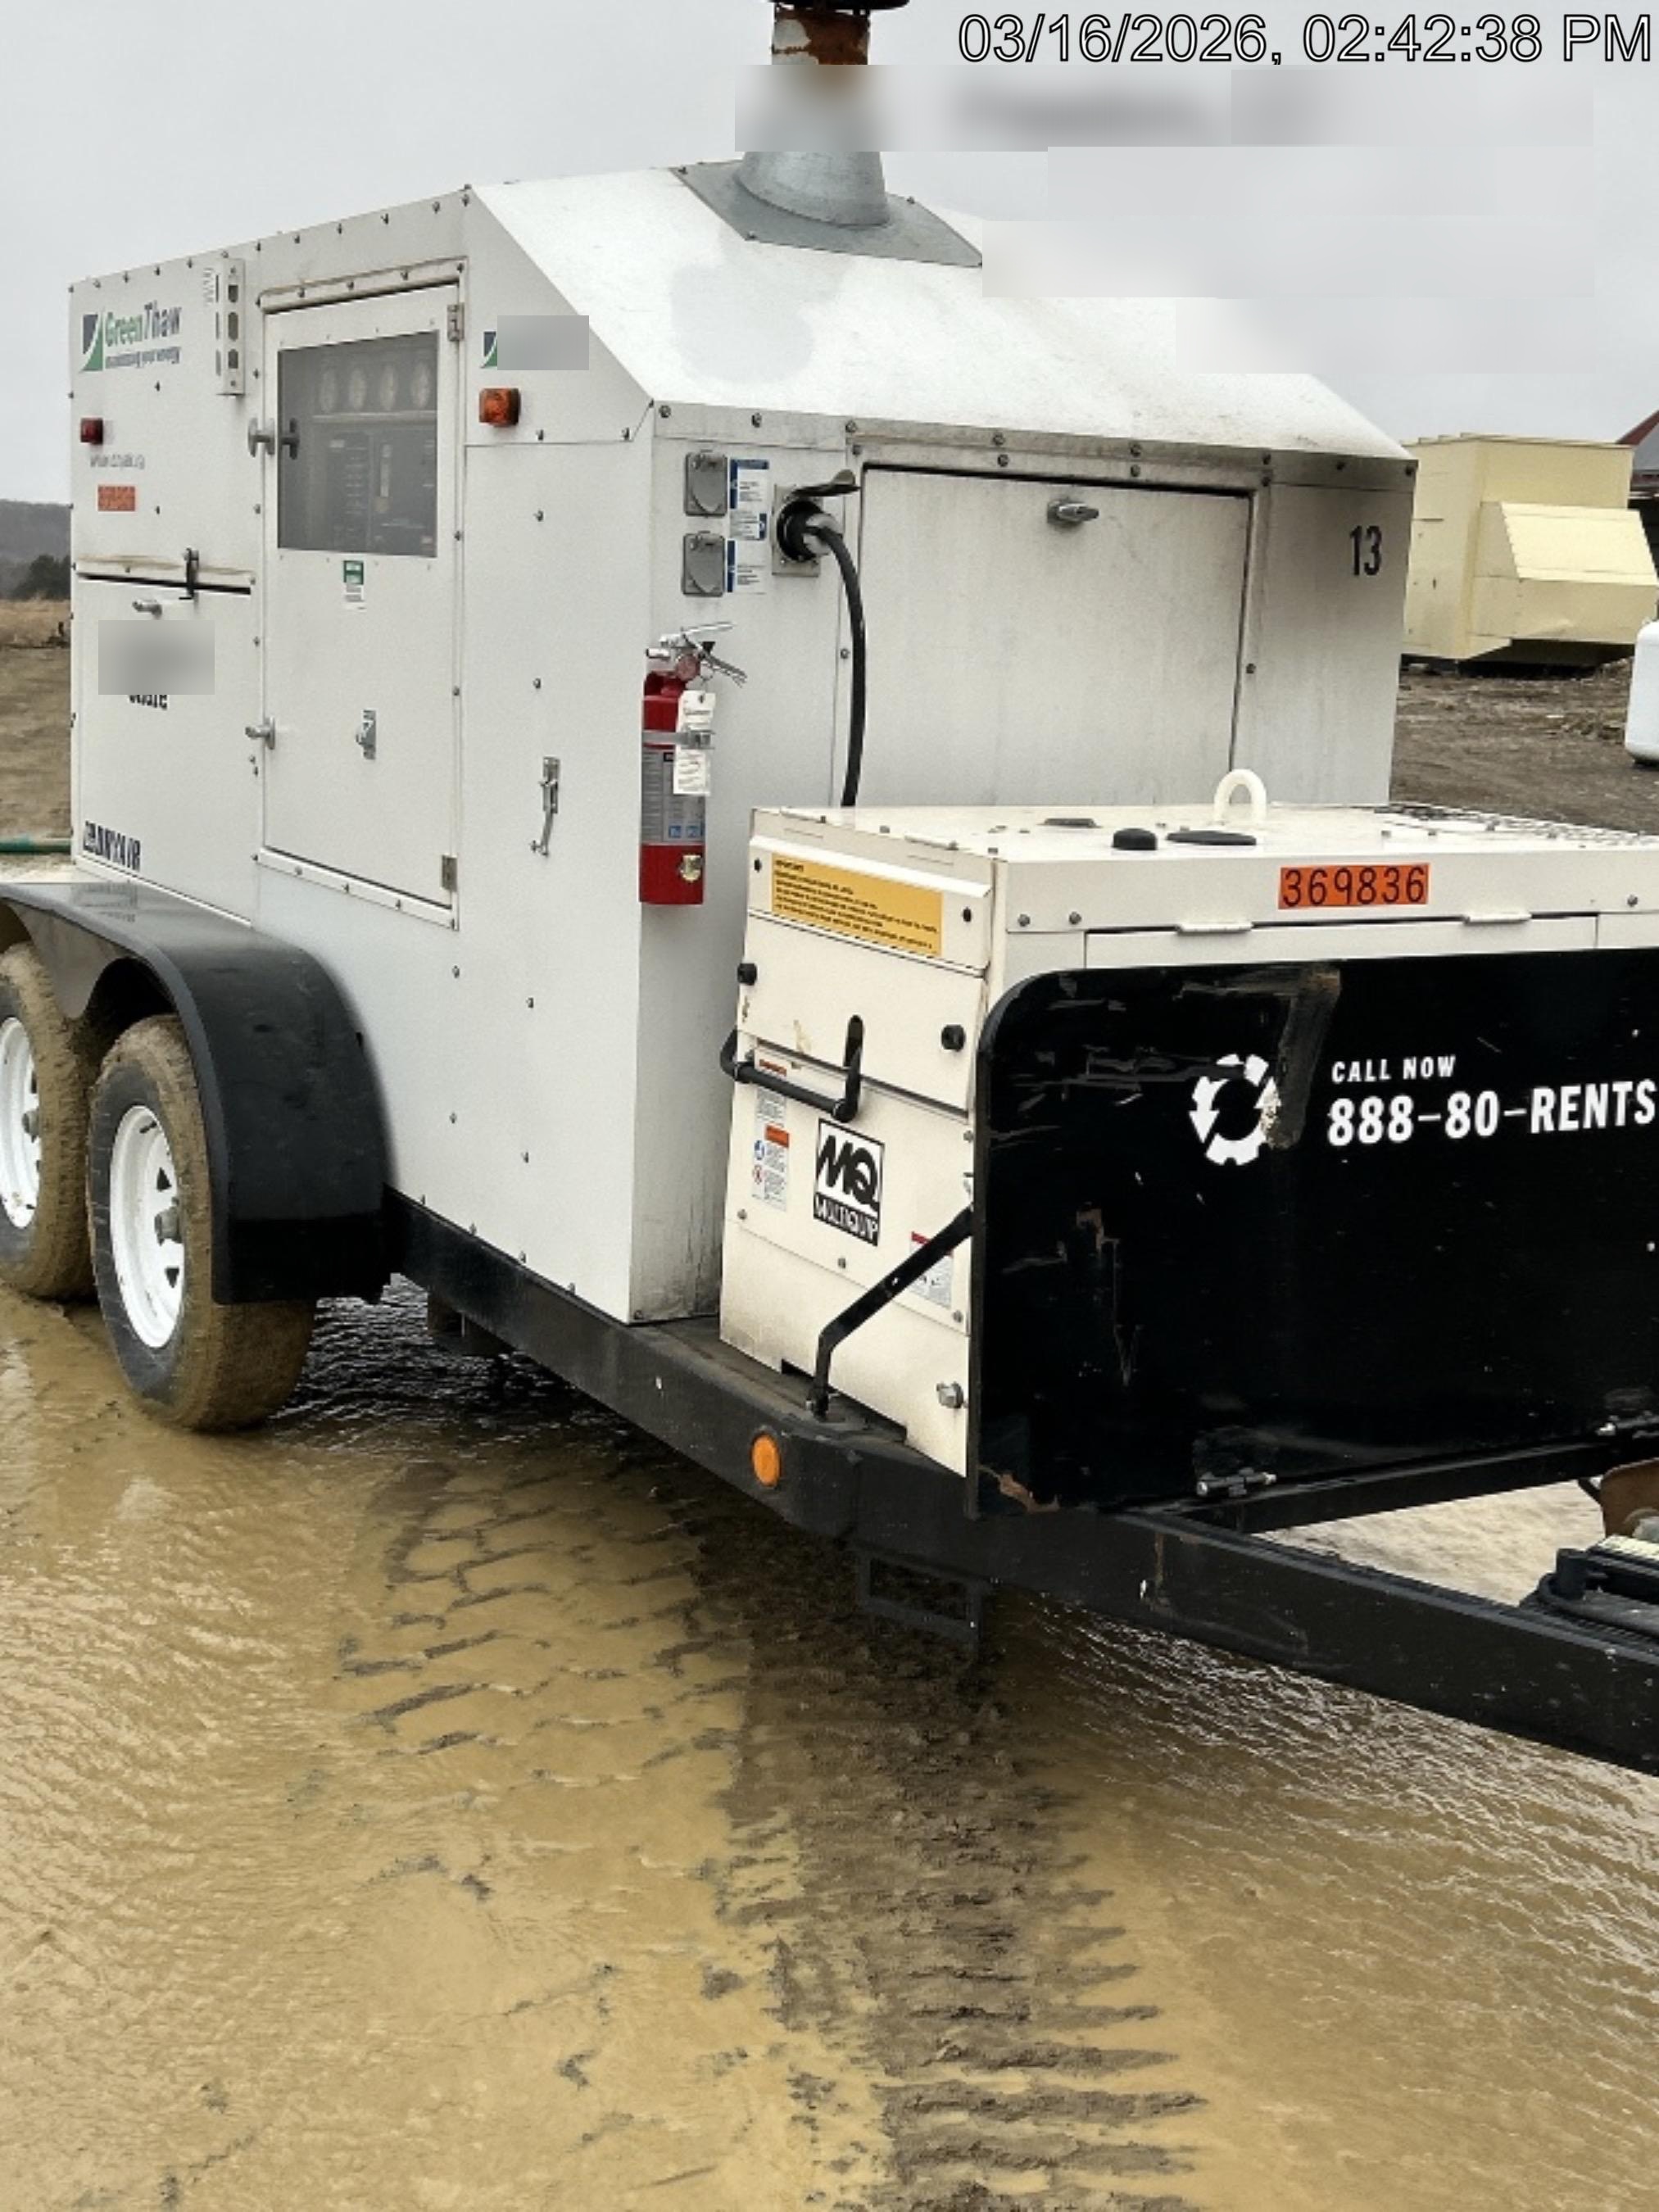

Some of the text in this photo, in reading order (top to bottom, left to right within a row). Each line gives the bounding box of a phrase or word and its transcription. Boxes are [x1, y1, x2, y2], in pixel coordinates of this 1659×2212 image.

[1349, 525, 1382, 576] 13
[1282, 866, 1426, 908] 369836
[1331, 1054, 1457, 1084] CALL NOW
[1327, 1078, 1657, 1147] 888-80-RENTS
[817, 1135, 880, 1213] MQ
